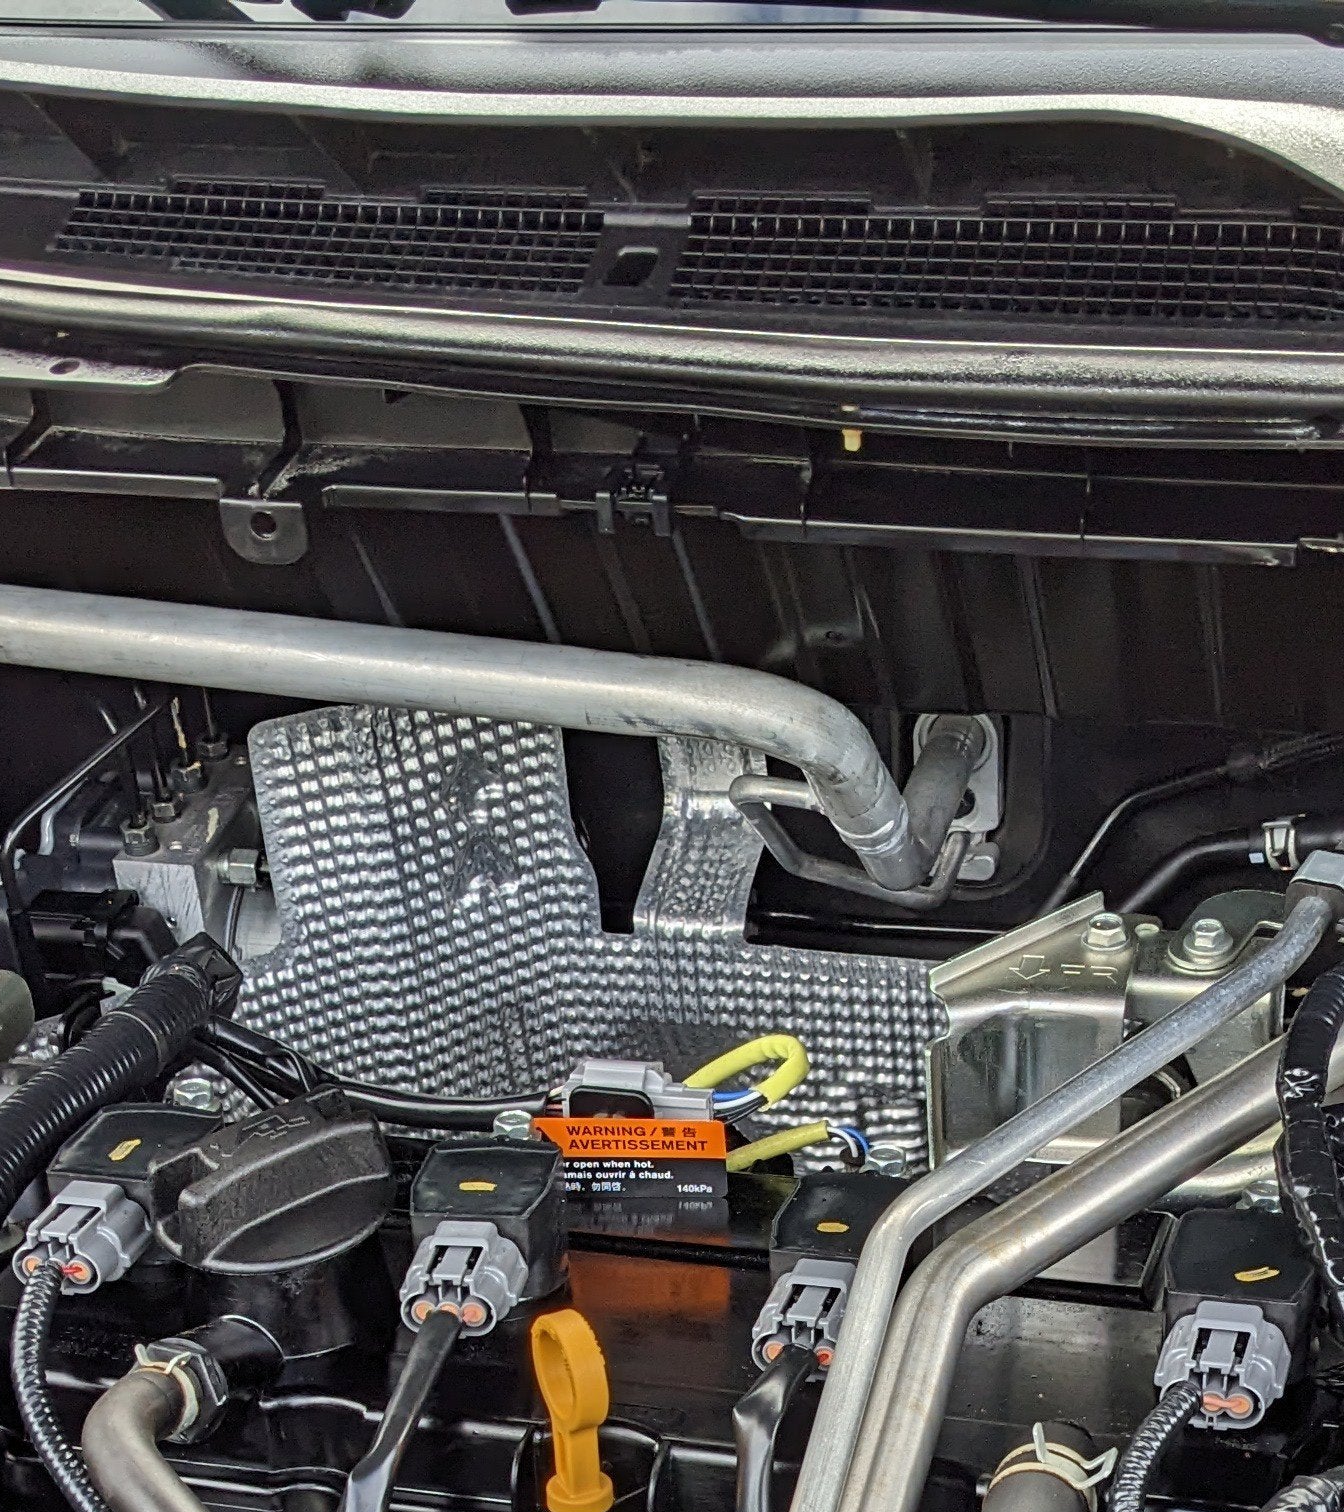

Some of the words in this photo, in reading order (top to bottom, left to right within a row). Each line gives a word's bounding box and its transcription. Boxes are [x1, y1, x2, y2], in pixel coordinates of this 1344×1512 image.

[566, 1126, 646, 1137] WARNING
[568, 1139, 708, 1151] AVERTISSEMENT
[573, 1161, 600, 1170] open
[602, 1160, 631, 1168] when
[634, 1160, 655, 1169] hot.
[564, 1171, 593, 1179] amais
[595, 1171, 627, 1179] ouvrir
[629, 1170, 636, 1179] à
[638, 1171, 674, 1180] chaud.
[676, 1184, 713, 1193] 140kPa
